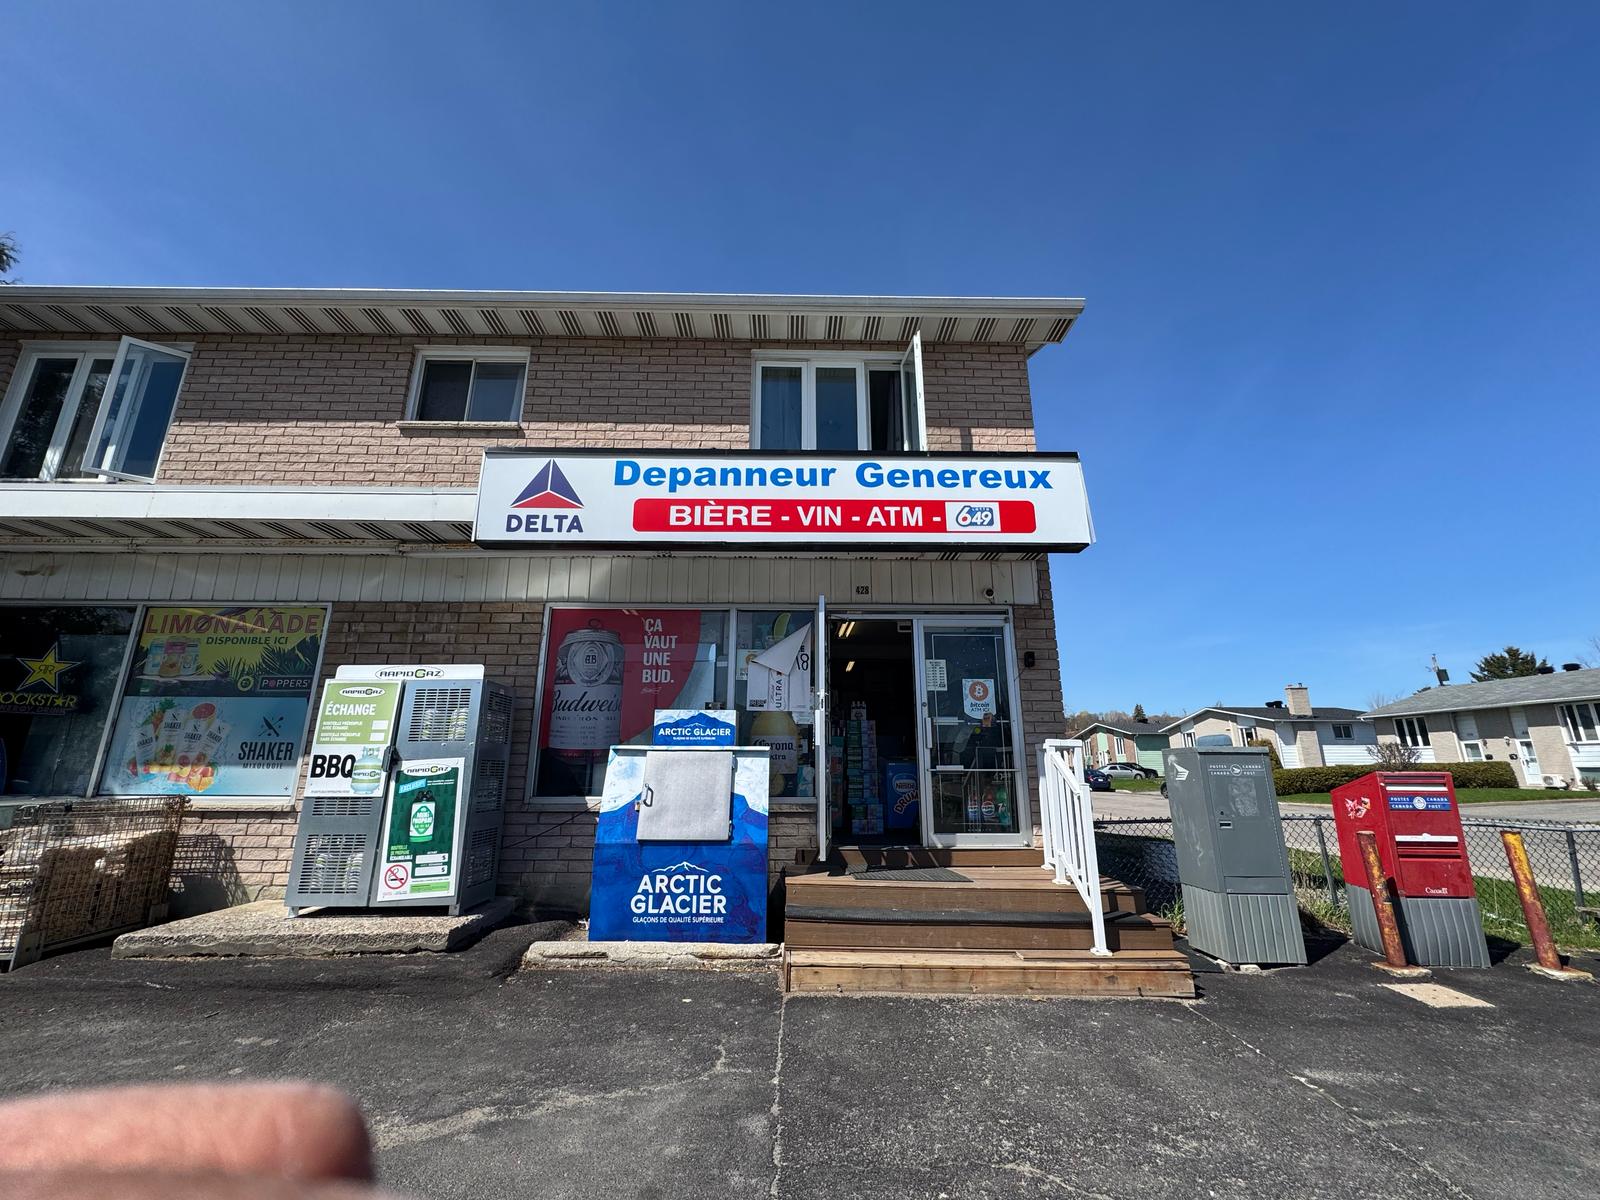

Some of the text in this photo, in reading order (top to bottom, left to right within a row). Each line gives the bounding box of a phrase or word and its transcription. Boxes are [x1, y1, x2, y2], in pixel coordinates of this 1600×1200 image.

[614, 460, 1053, 492] Depanneur Genereux
[669, 501, 772, 526] BIÈRE
[797, 506, 841, 526] VIN
[866, 507, 923, 526] ATM
[506, 515, 584, 533] DELTA
[855, 586, 869, 595] 428
[644, 618, 663, 635] ÇA
[206, 636, 288, 645] DISPONIBLE ICI
[644, 635, 677, 649] VAUT
[643, 652, 671, 666] UNE
[642, 669, 675, 683] BUD.
[0, 692, 77, 707] OCKSTAR
[552, 689, 621, 713] Budweis
[775, 679, 783, 708] ULTRA
[325, 701, 377, 715] ÉCHANGE
[658, 728, 731, 736] ARCTIC GLACIER
[238, 742, 294, 761] SHAKER
[753, 738, 793, 750] Corona
[310, 754, 356, 778] BBQ
[637, 874, 722, 894] ARCTIC
[630, 894, 727, 914] GLACIER
[632, 916, 659, 924] GLAÇONS
[668, 915, 691, 923] QUALITÉ
[692, 915, 724, 923] SUPÉRIEURE
